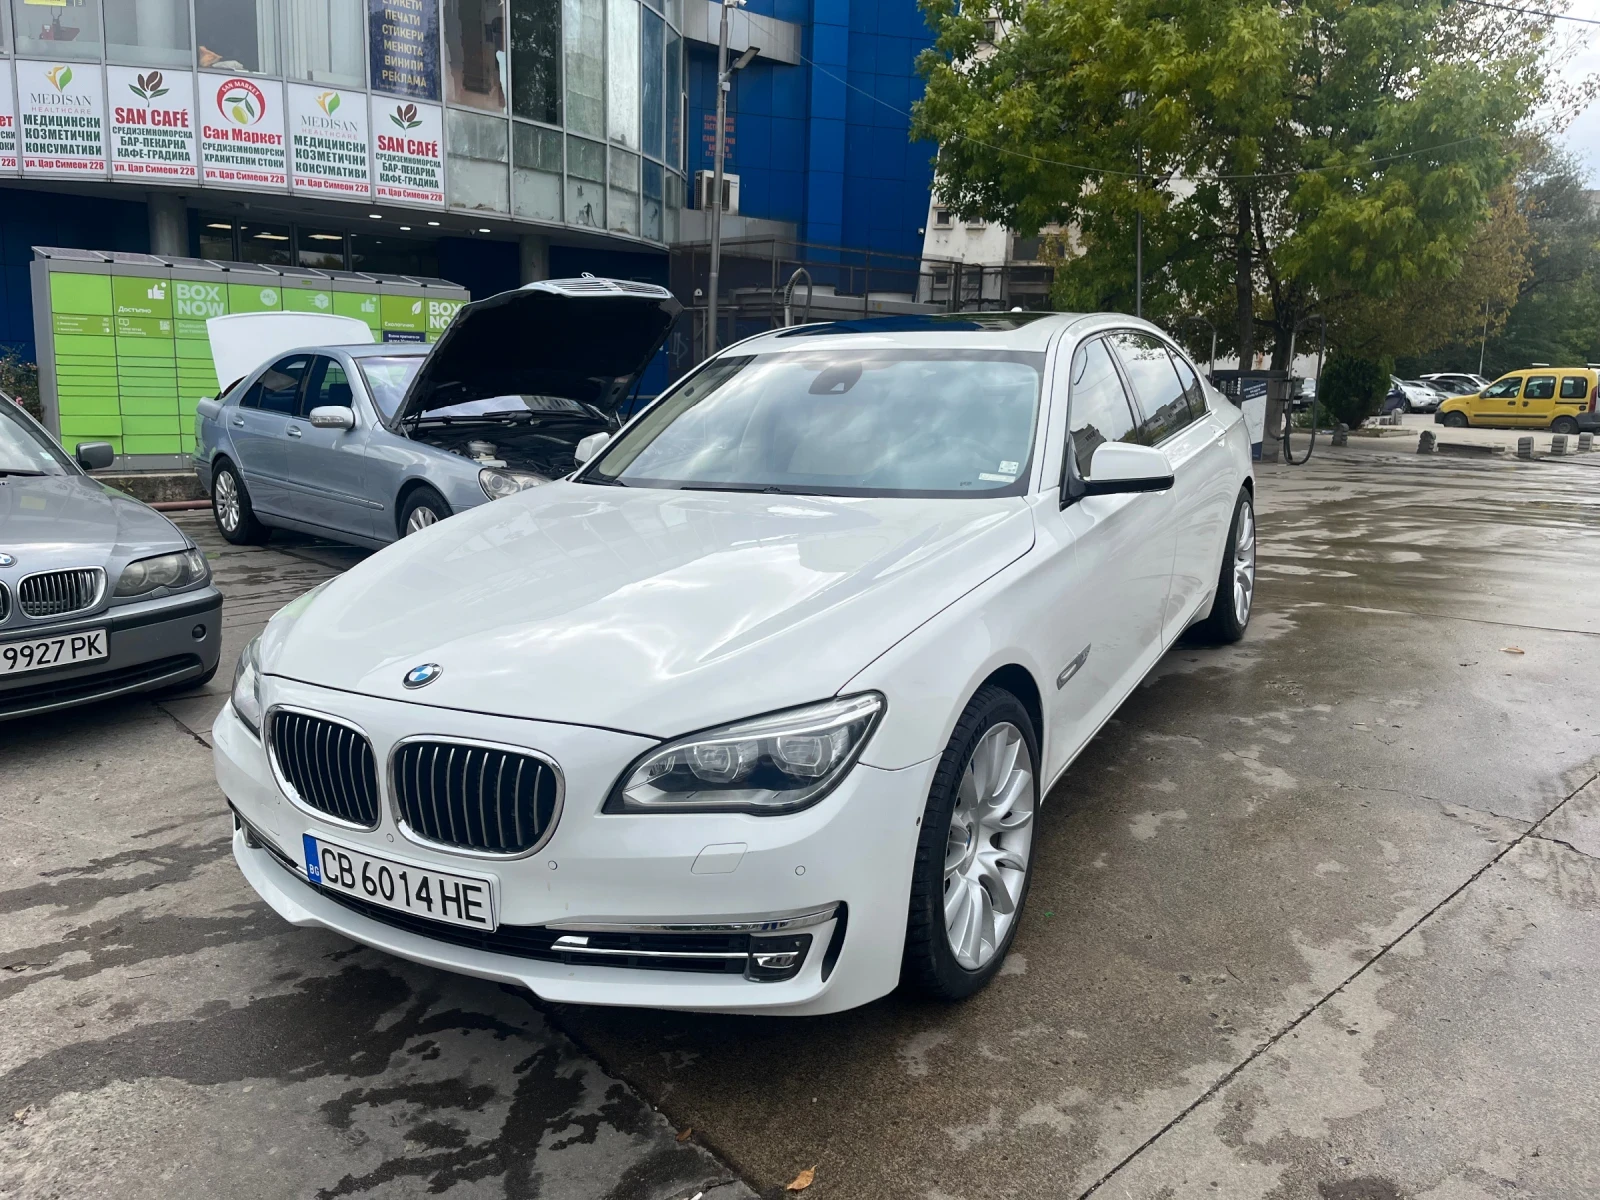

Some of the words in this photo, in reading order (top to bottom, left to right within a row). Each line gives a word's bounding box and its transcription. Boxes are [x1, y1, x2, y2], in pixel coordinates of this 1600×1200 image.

[385, 9, 420, 26] ПЕЧАТИ
[382, 24, 424, 42] СТИКЕРИ
[383, 39, 424, 57] МЕНЮТА
[384, 55, 424, 71] ВИНИЛИ
[382, 69, 427, 87] РЕКЛАМА
[221, 83, 233, 92] SAN
[234, 81, 260, 96] MARKET
[30, 93, 92, 106] MEDISAN
[31, 106, 92, 115] HEALTHCARE
[115, 107, 147, 125] SAN
[151, 109, 189, 128] CAFÉ
[23, 114, 101, 128] МЕДИЦИНСКИ
[301, 115, 358, 132] MEDISAN
[25, 128, 101, 141] КОЗМЕТИЧНИ
[112, 126, 193, 139] СРЕДИЗЕМНОМОРСКА
[203, 125, 229, 140] Сан
[232, 128, 282, 145] Маркет
[302, 128, 358, 140] HEALTHCARE
[25, 142, 102, 156] КОНСУМАТИВИ
[120, 136, 186, 150] БАР-ПЕКАРНА
[202, 142, 285, 157] СРЕДИЗЕМНОМОРСКИ
[294, 135, 366, 153] МЕДИЦИНСКИ
[377, 135, 406, 154] SAN
[407, 139, 438, 158] CAFÉ
[1, 158, 16, 167] 228
[117, 148, 191, 162] КАФЕ-ГРАДИНА
[204, 154, 257, 167] ХРАНИТЕЛНИ
[258, 157, 284, 168] СТОКИ
[295, 148, 366, 166] КОЗМЕТИЧНИ
[375, 152, 441, 168] СРЕДИЗЕМНОМОРСКА
[25, 159, 36, 168] ул.
[38, 159, 54, 169] Цар
[55, 159, 88, 169] Симеон
[89, 161, 104, 170] 228
[114, 163, 126, 172] ул.
[127, 164, 144, 174] Цар
[145, 165, 178, 174] Симеон
[180, 167, 195, 176] 228
[296, 162, 367, 179] КОНСУМАТИВИ
[382, 162, 436, 178] БАР-ПЕКАРНА
[206, 170, 216, 178] ул.
[218, 170, 235, 180] Цар
[236, 171, 268, 182] Симеон
[270, 174, 285, 184] 228
[380, 172, 439, 189] КАФЕ-ГРАДИНА
[295, 178, 306, 187] ул.
[307, 178, 323, 189] Цар
[324, 180, 353, 191] Симеон
[355, 183, 369, 193] 228
[377, 187, 387, 195] ул.
[389, 187, 402, 197] Цар
[402, 189, 429, 200] Симеон
[430, 192, 443, 202] 228
[176, 283, 220, 301] BOX
[118, 305, 152, 314] Достъпно
[177, 300, 224, 317] NOW
[429, 315, 454, 329] NO
[3, 639, 66, 670] 9927
[70, 633, 103, 660] PK
[309, 863, 320, 877] BG
[321, 847, 356, 889] CB
[361, 861, 434, 913] 6014
[438, 879, 487, 924] HE
